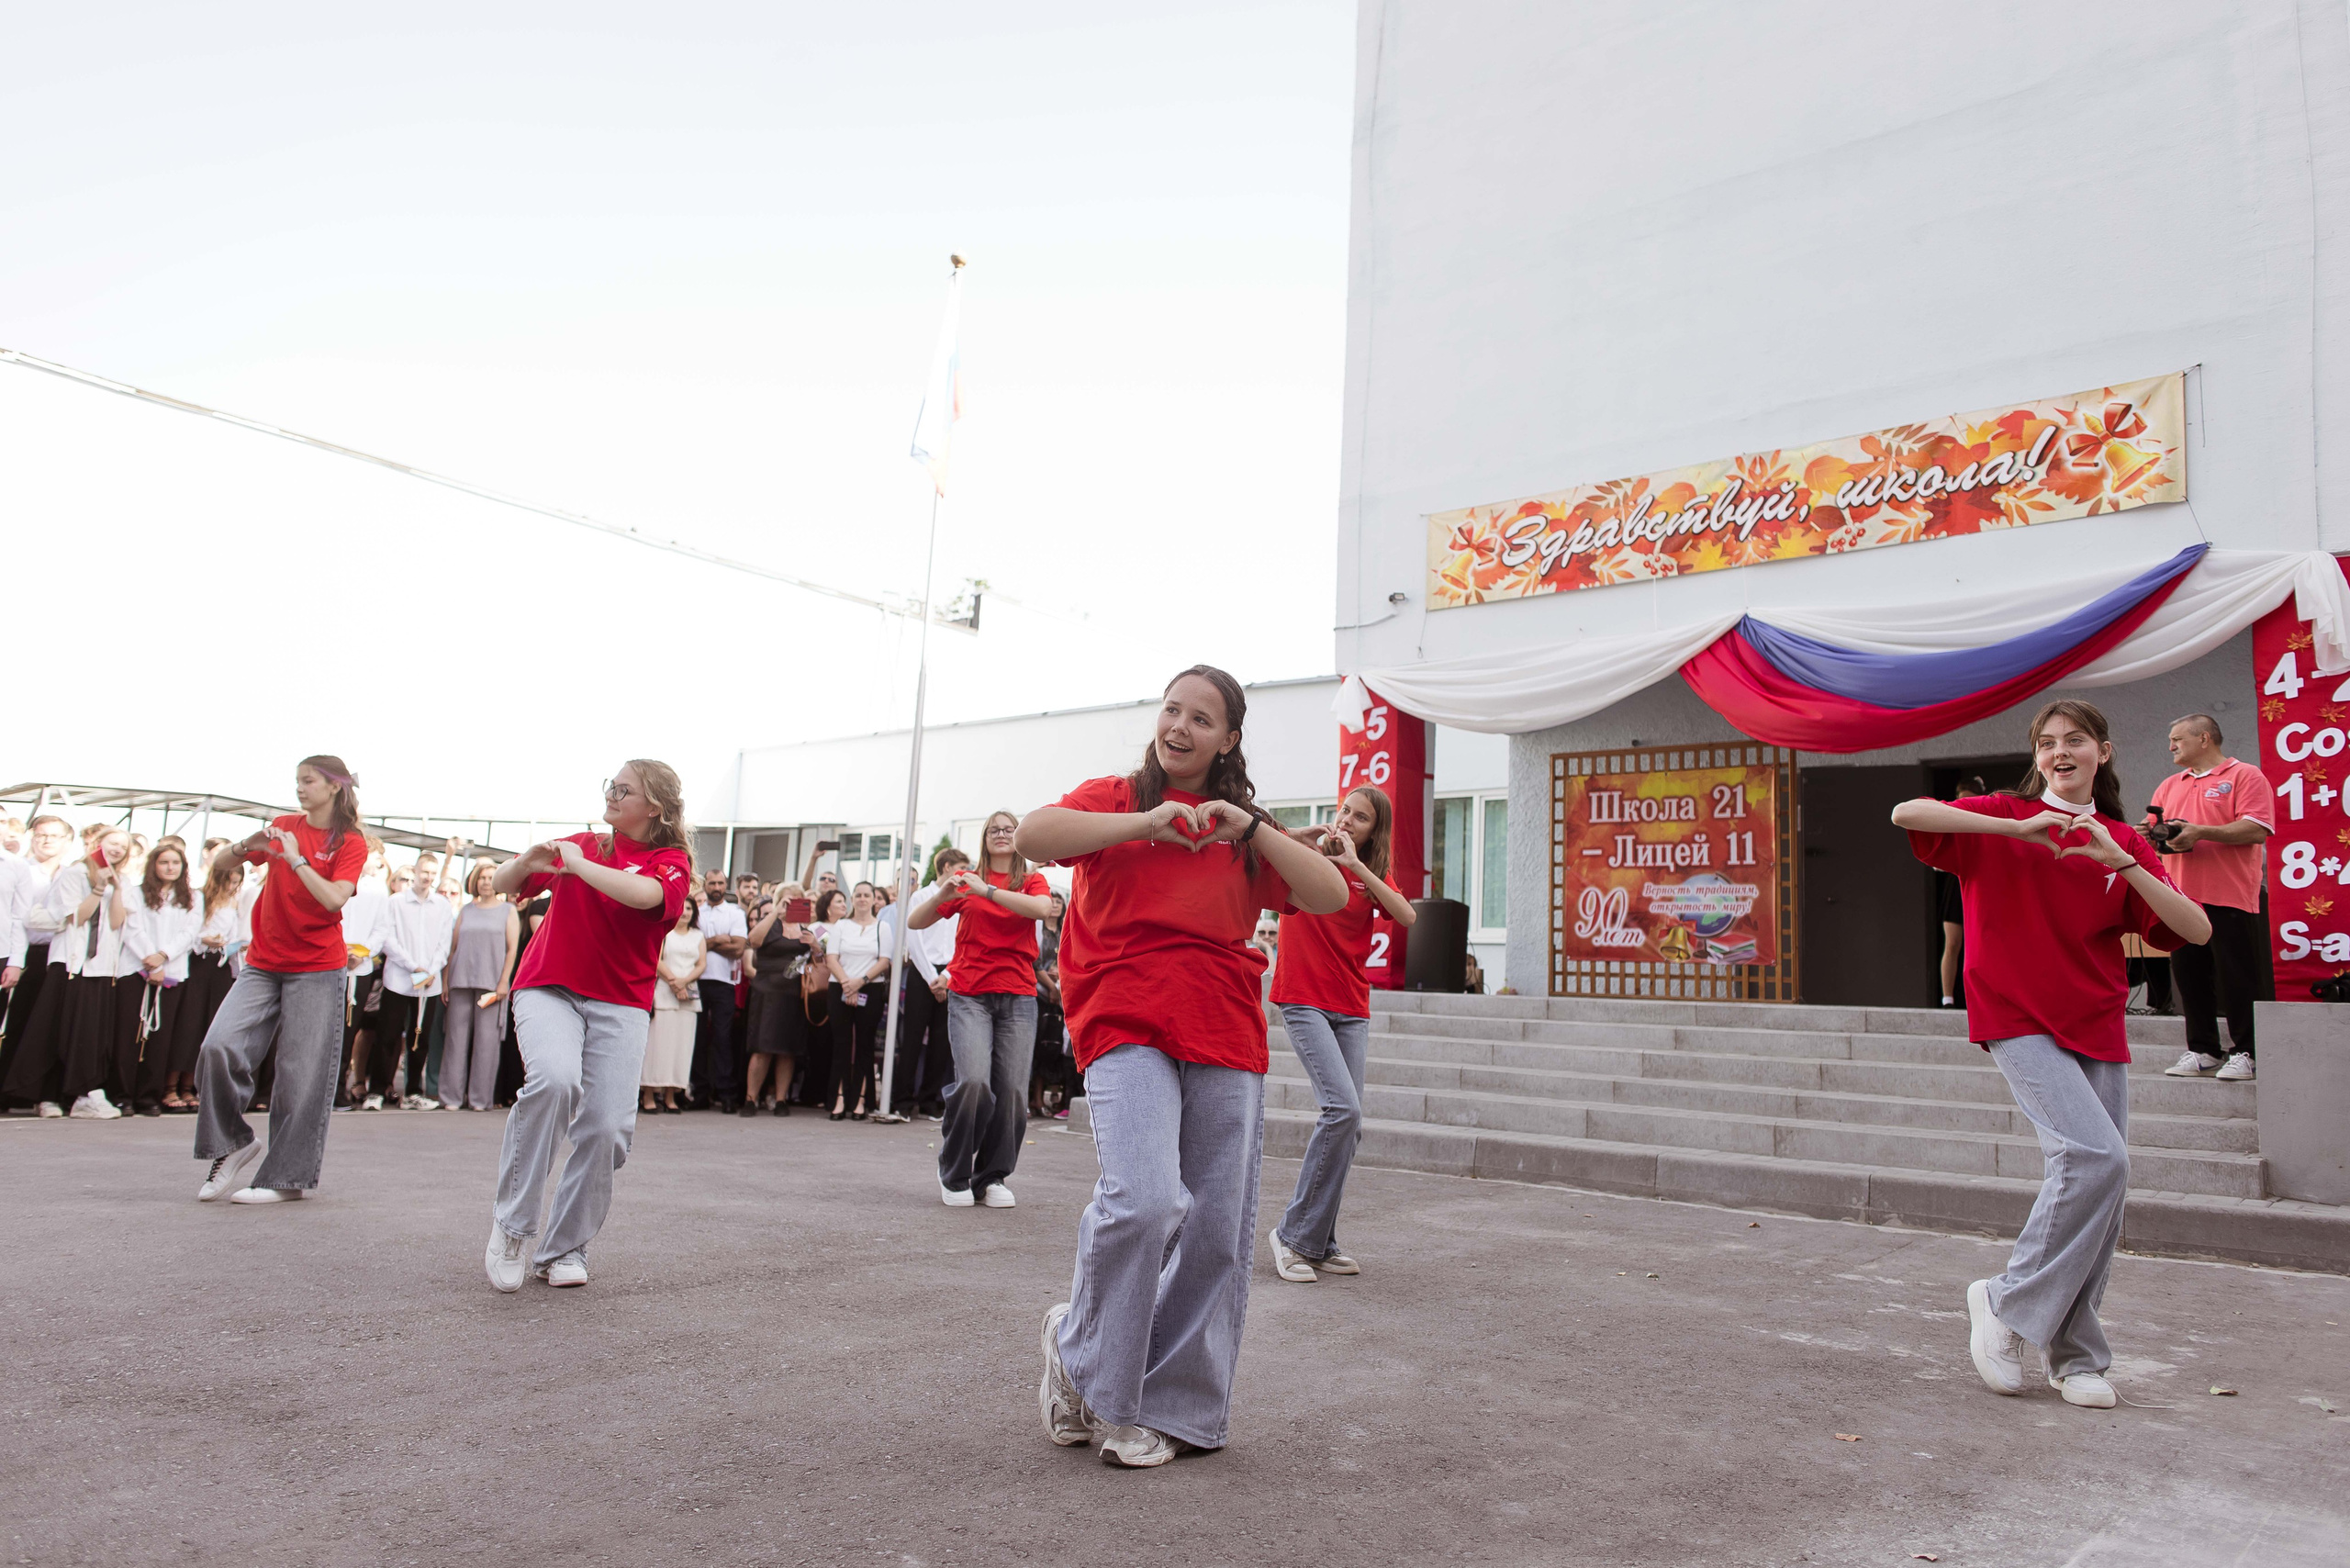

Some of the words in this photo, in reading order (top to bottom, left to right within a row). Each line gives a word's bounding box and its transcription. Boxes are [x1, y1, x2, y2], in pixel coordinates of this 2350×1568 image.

[1501, 480, 1808, 577] Здравствуй,
[1836, 425, 2057, 509] школа!
[2276, 722, 2350, 763] Co
[1341, 750, 1390, 788] 7-6
[1589, 790, 1695, 823] Школа
[1713, 784, 1746, 819] 21
[2277, 772, 2350, 821] 1+
[1608, 834, 1710, 872] Лицей
[1726, 831, 1755, 866] 11
[1644, 884, 1691, 898] Верность
[1695, 883, 1758, 897] традициям,
[1651, 902, 1717, 913] открытость
[1721, 901, 1751, 914] миру!
[1574, 886, 1628, 938] 90
[1593, 929, 1645, 946] лет
